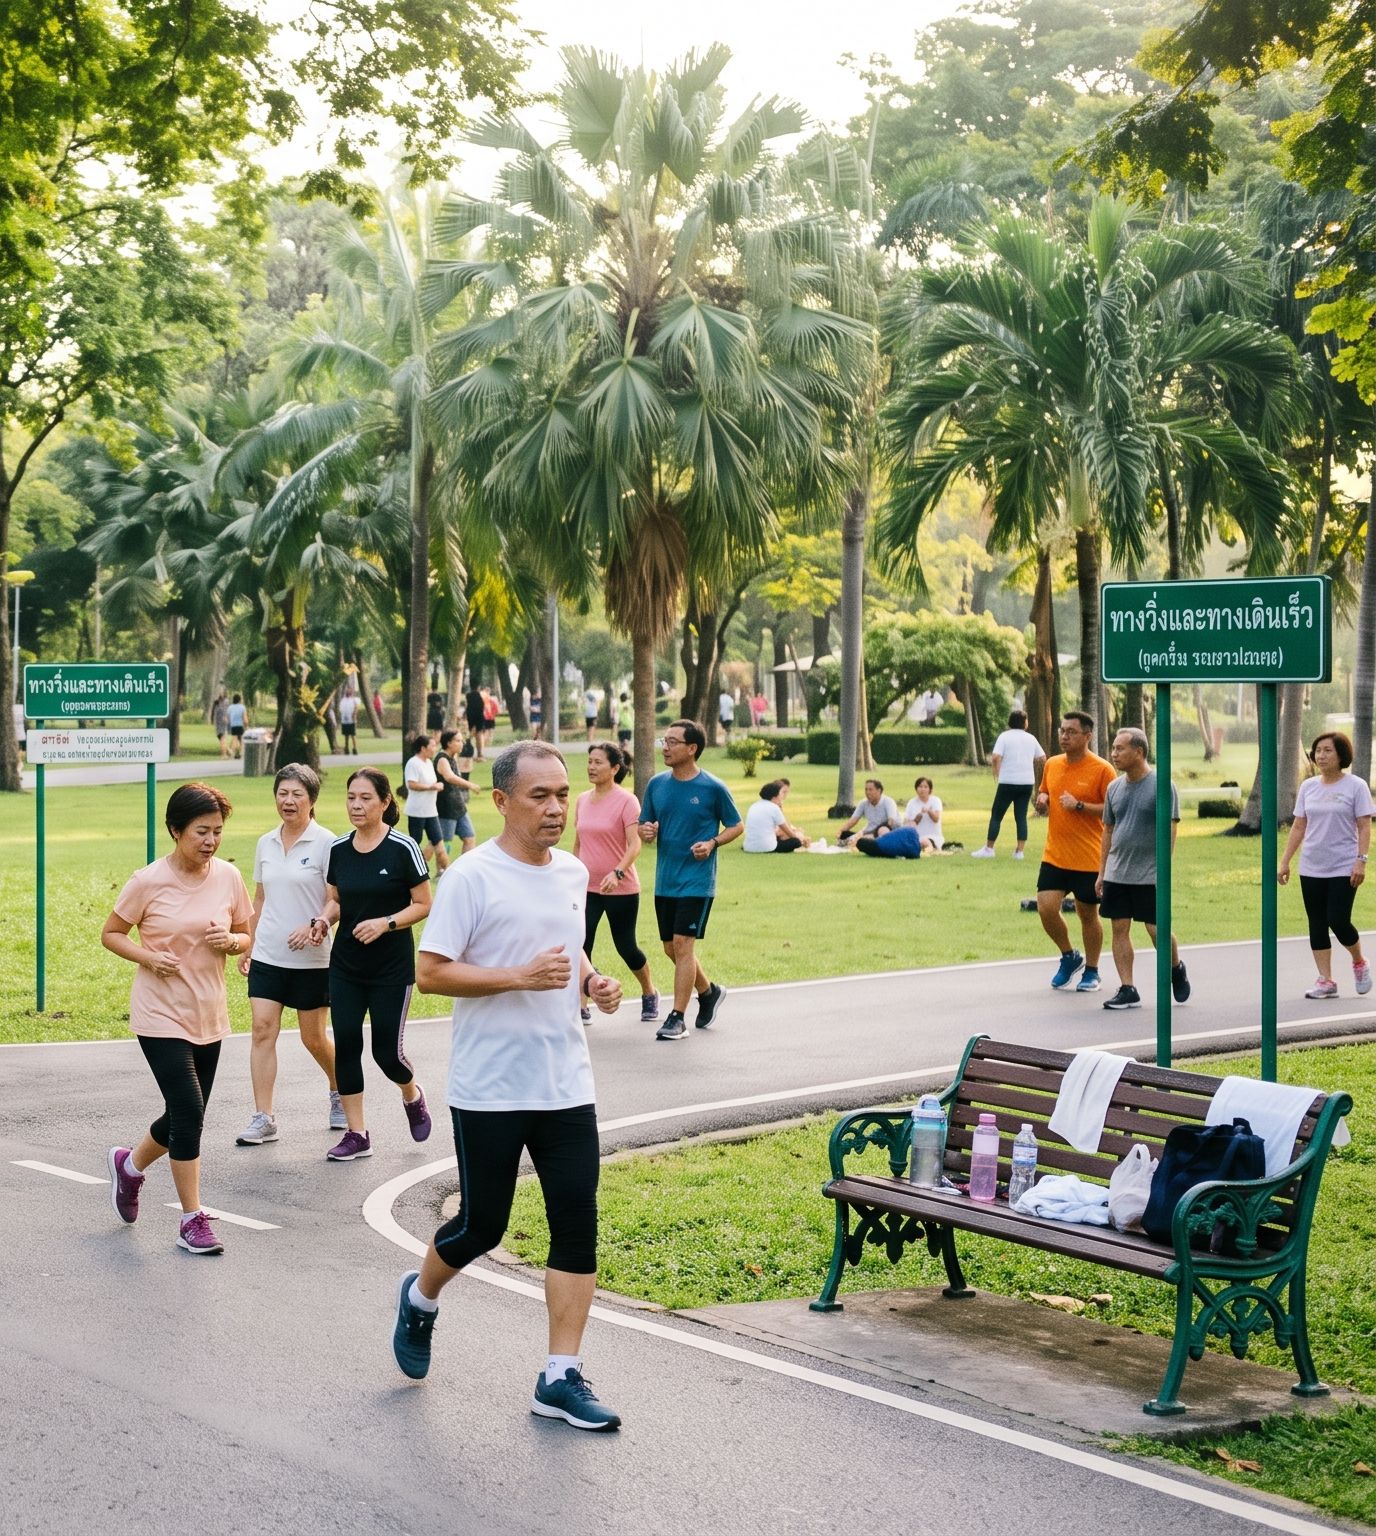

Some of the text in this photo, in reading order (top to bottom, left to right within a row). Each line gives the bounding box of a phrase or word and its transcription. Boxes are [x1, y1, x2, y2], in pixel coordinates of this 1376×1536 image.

[1110, 591, 1313, 632] ทางวิ่งและทางเดินเร็ว
